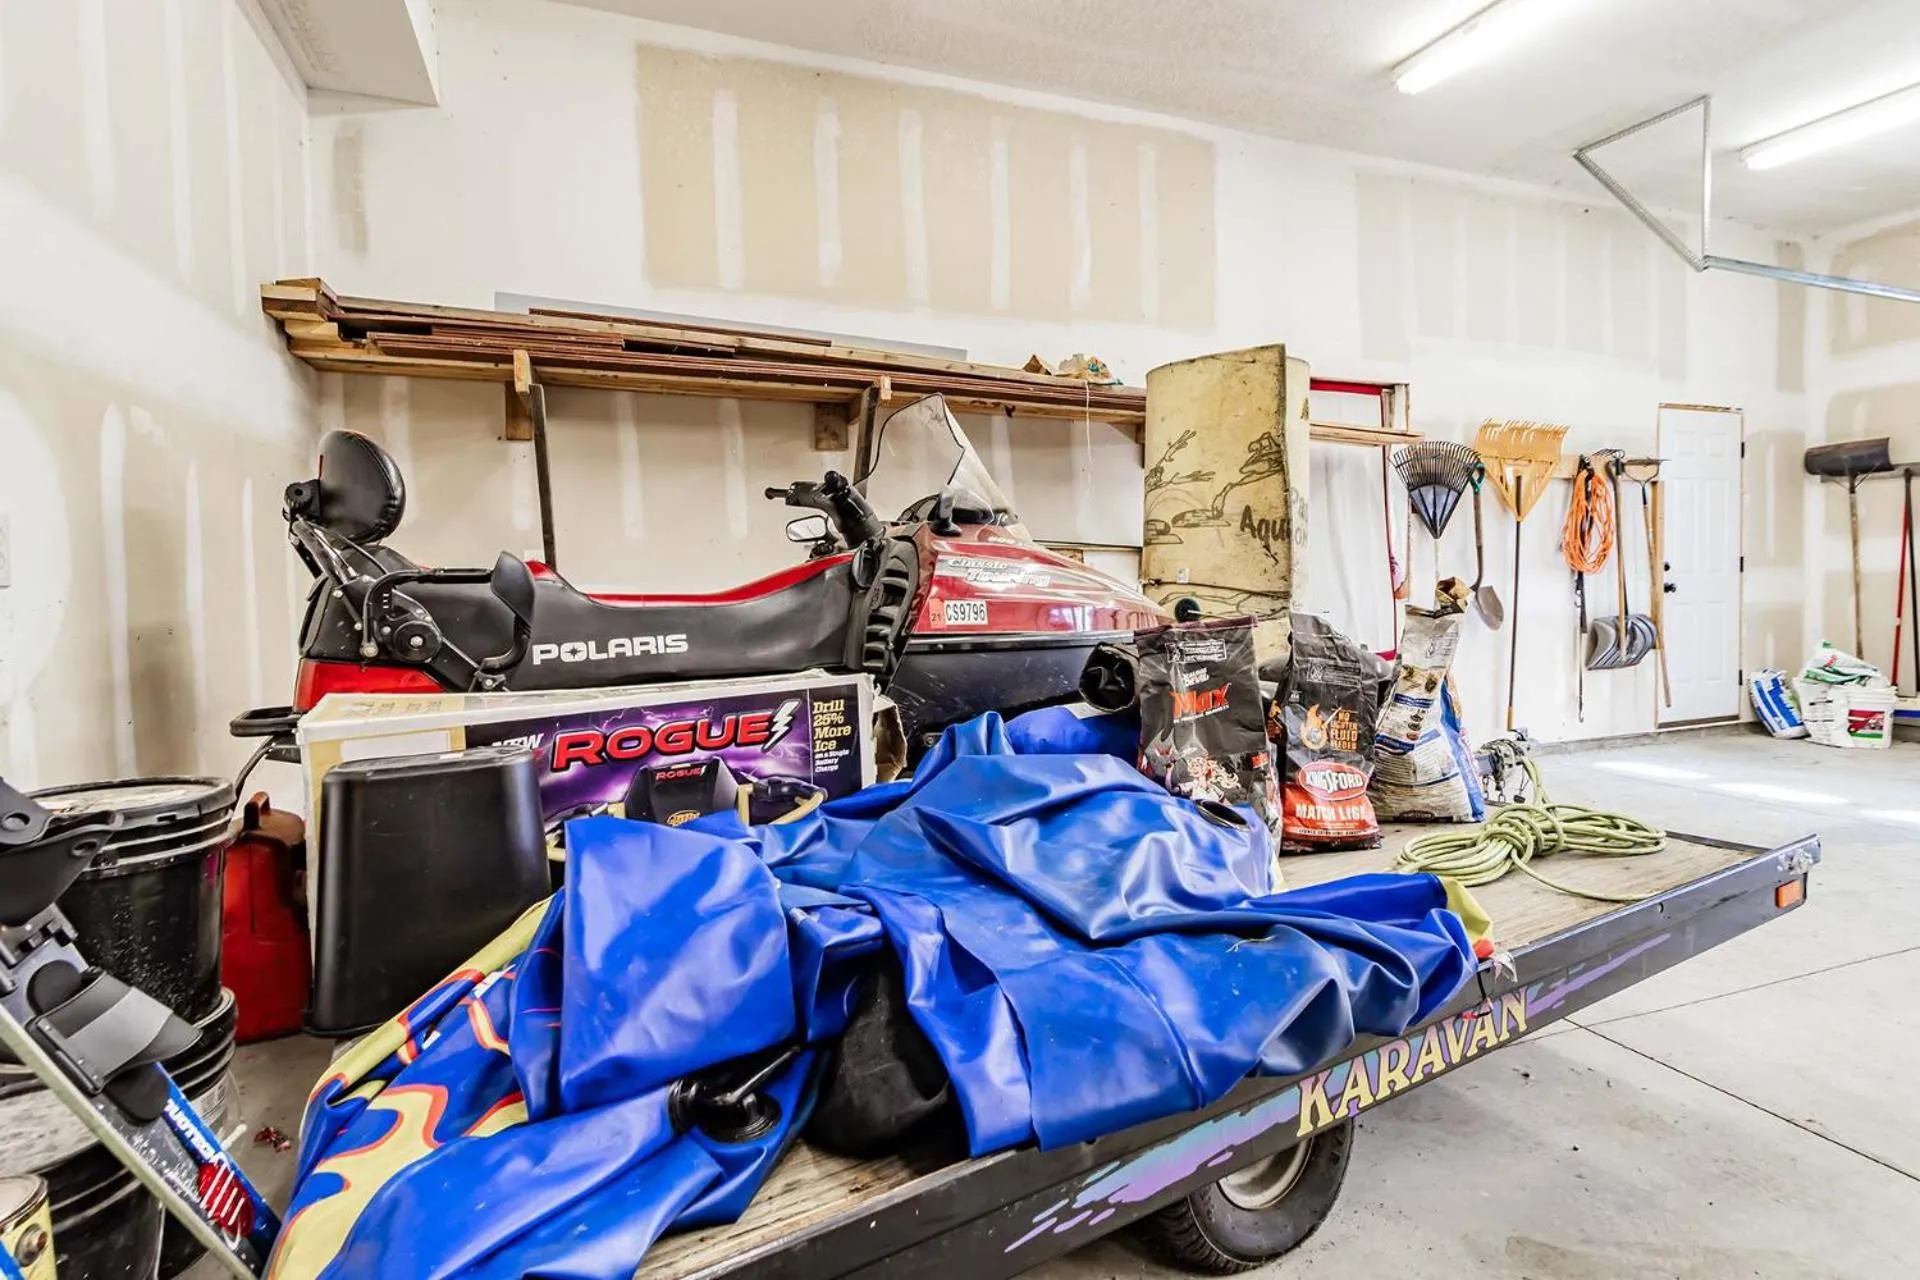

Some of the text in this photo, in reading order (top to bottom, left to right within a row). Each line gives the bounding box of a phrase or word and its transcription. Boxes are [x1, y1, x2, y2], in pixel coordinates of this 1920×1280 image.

[945, 603, 986, 622] CS9796
[532, 633, 688, 665] POLARIS
[813, 699, 845, 714] Drill
[813, 712, 845, 727] 25%
[814, 725, 852, 740] More
[552, 712, 770, 771] ROGUE
[814, 740, 837, 753] Ice
[656, 767, 701, 780] ROGUE
[1296, 986, 1528, 1137] KARAVAN
